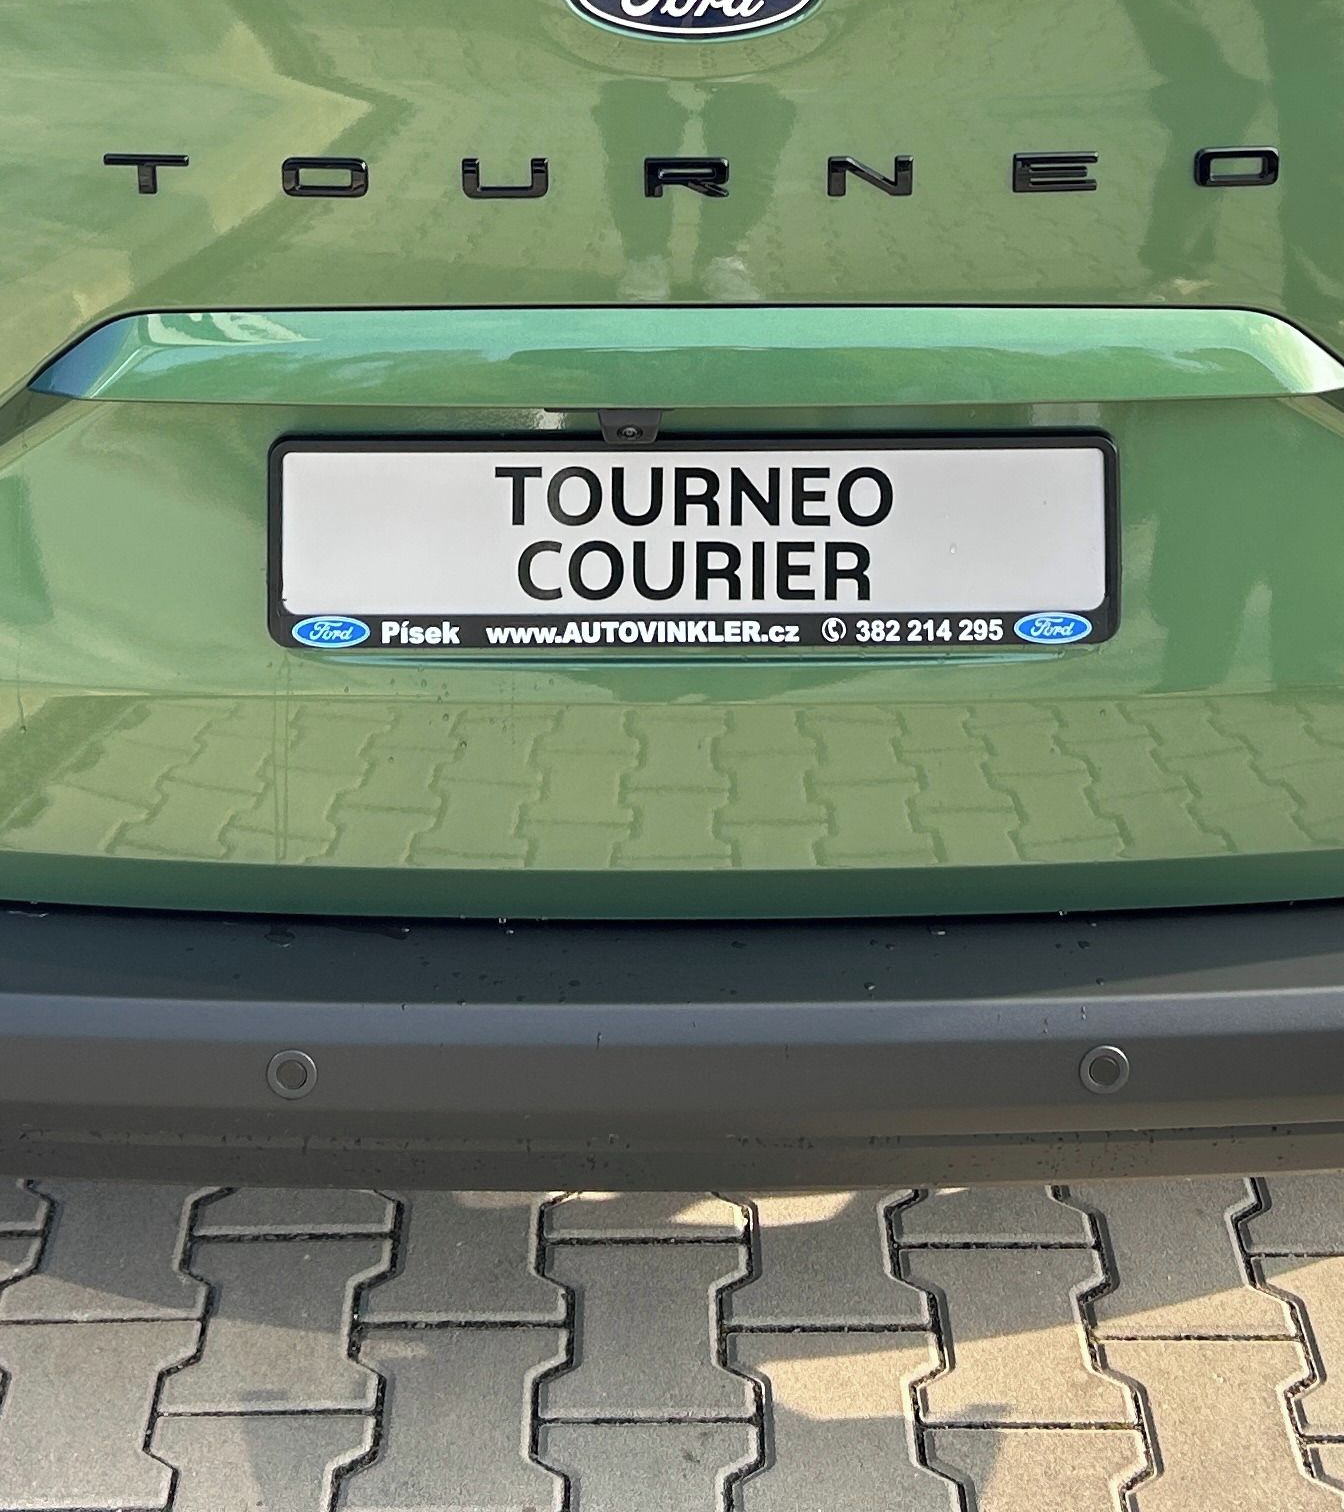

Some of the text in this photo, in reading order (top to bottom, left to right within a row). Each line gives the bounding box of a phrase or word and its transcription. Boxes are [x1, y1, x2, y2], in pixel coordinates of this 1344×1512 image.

[103, 146, 1280, 199] TOURNEO
[494, 466, 894, 527] TOURNEO
[517, 540, 871, 601] COURIER
[308, 618, 1076, 644] Ford Písek www.AUTOVINKLER.cz 382 214 295 Ford
